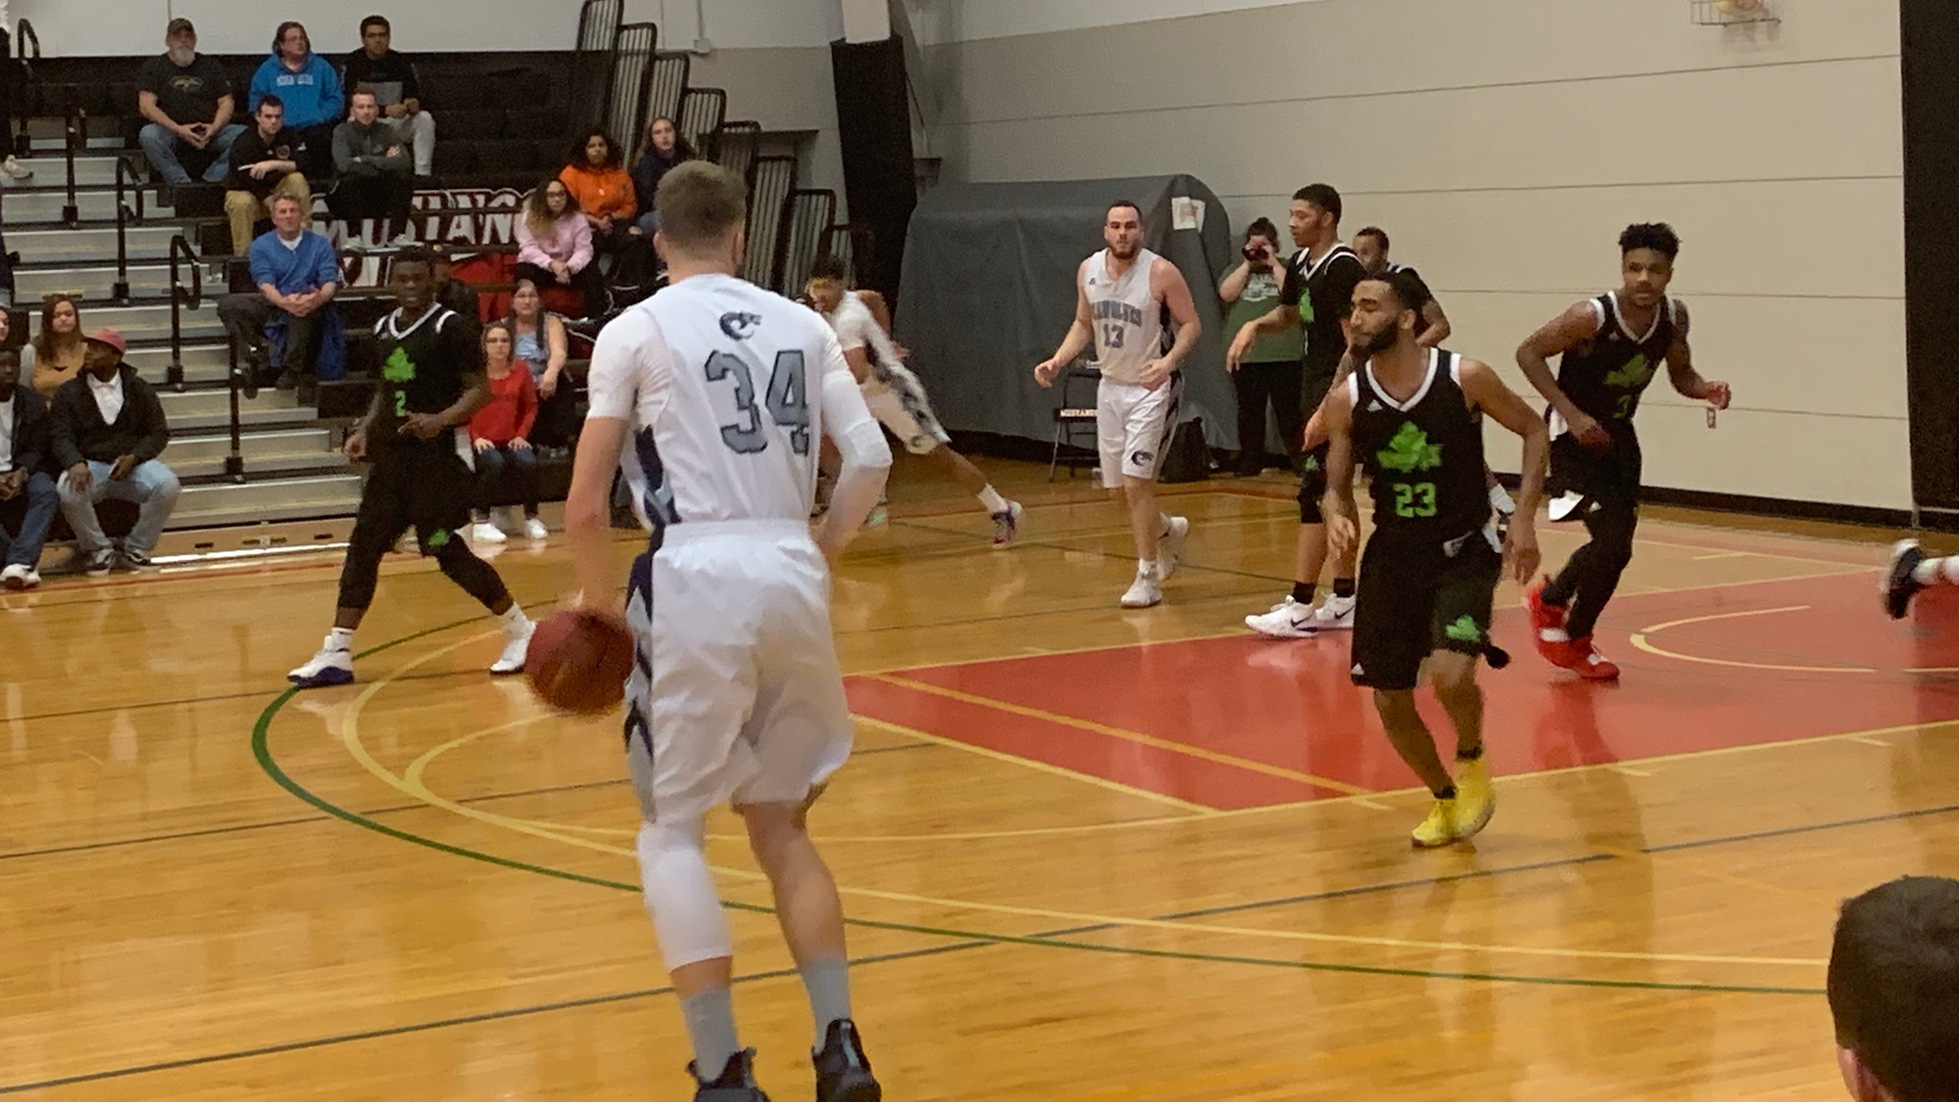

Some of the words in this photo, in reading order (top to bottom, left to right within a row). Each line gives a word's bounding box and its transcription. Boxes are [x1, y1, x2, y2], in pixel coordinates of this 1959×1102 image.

[1103, 323, 1125, 349] 13
[394, 390, 407, 417] 2
[704, 349, 810, 457] 34
[1060, 408, 1098, 418] MUSTANG
[1393, 482, 1437, 518] 23
